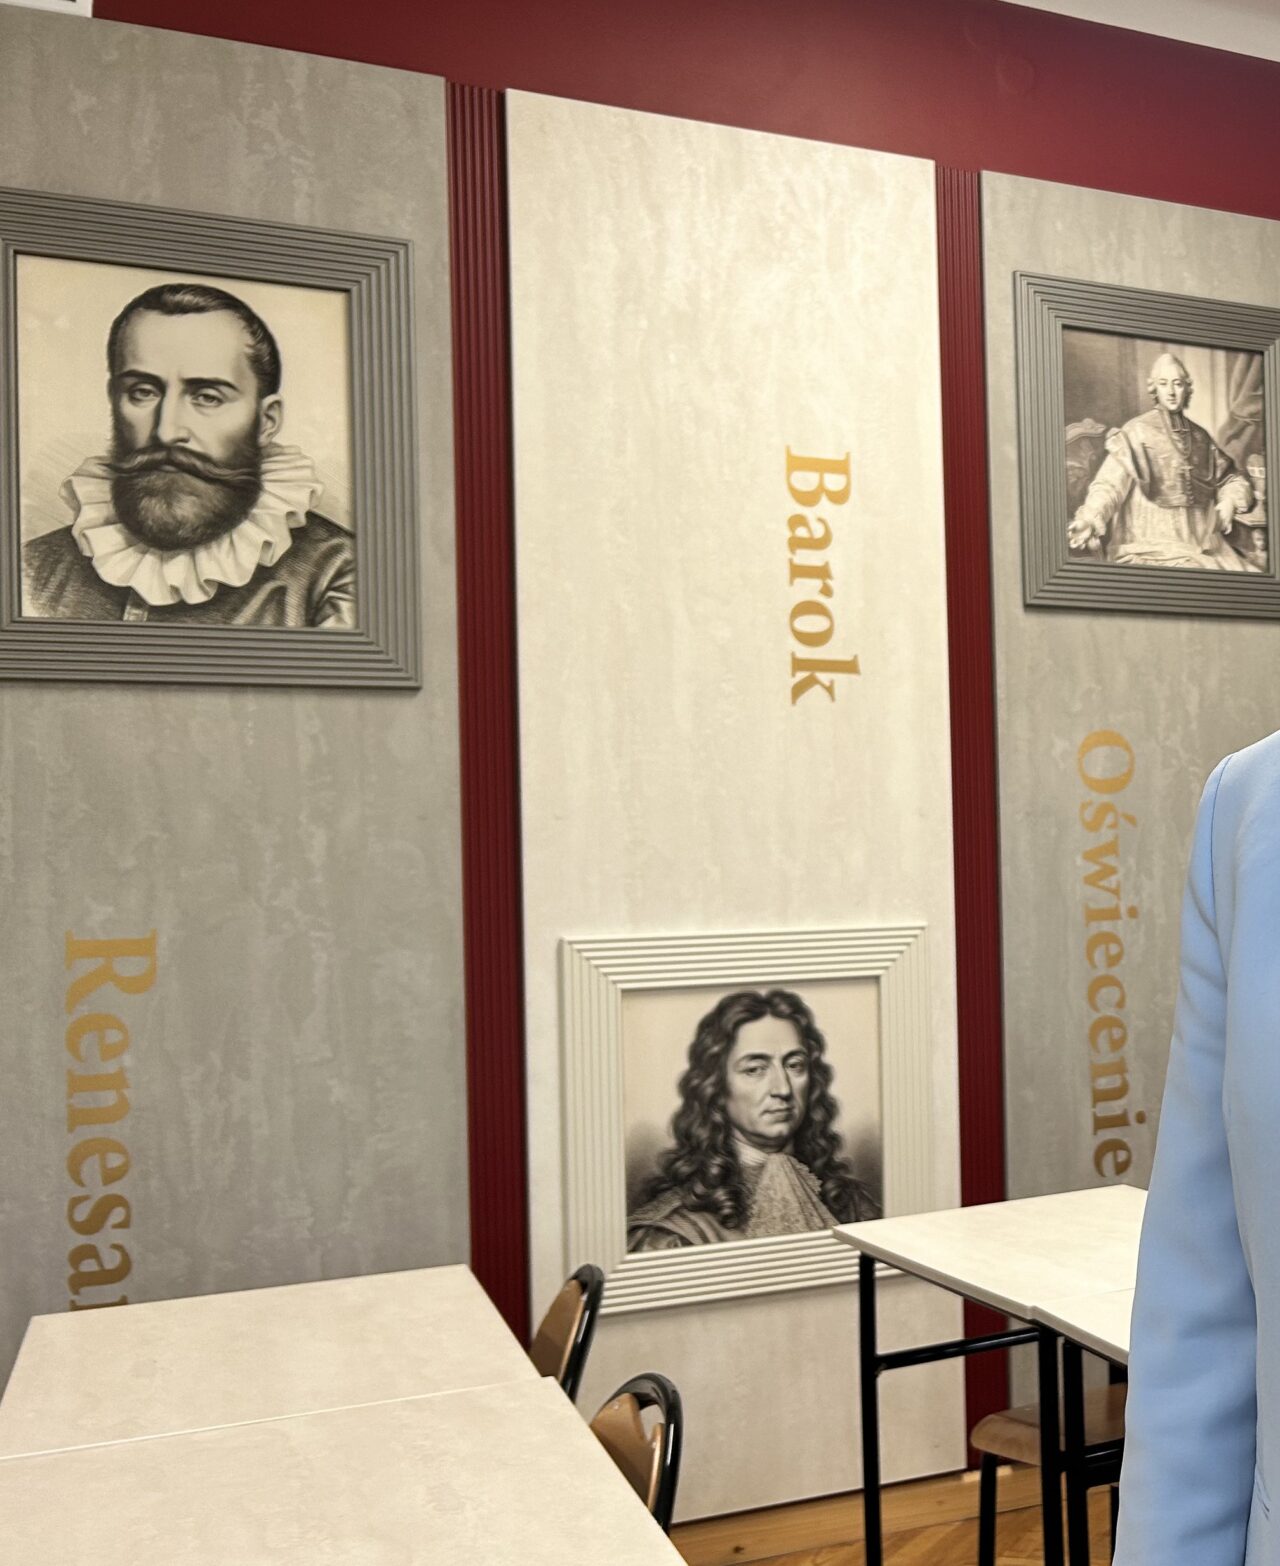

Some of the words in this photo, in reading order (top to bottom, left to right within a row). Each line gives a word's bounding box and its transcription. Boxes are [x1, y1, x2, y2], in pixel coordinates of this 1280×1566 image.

[785, 444, 861, 705] Barok
[64, 928, 157, 1312] Renesa
[1077, 729, 1147, 1178] Oświecenie
